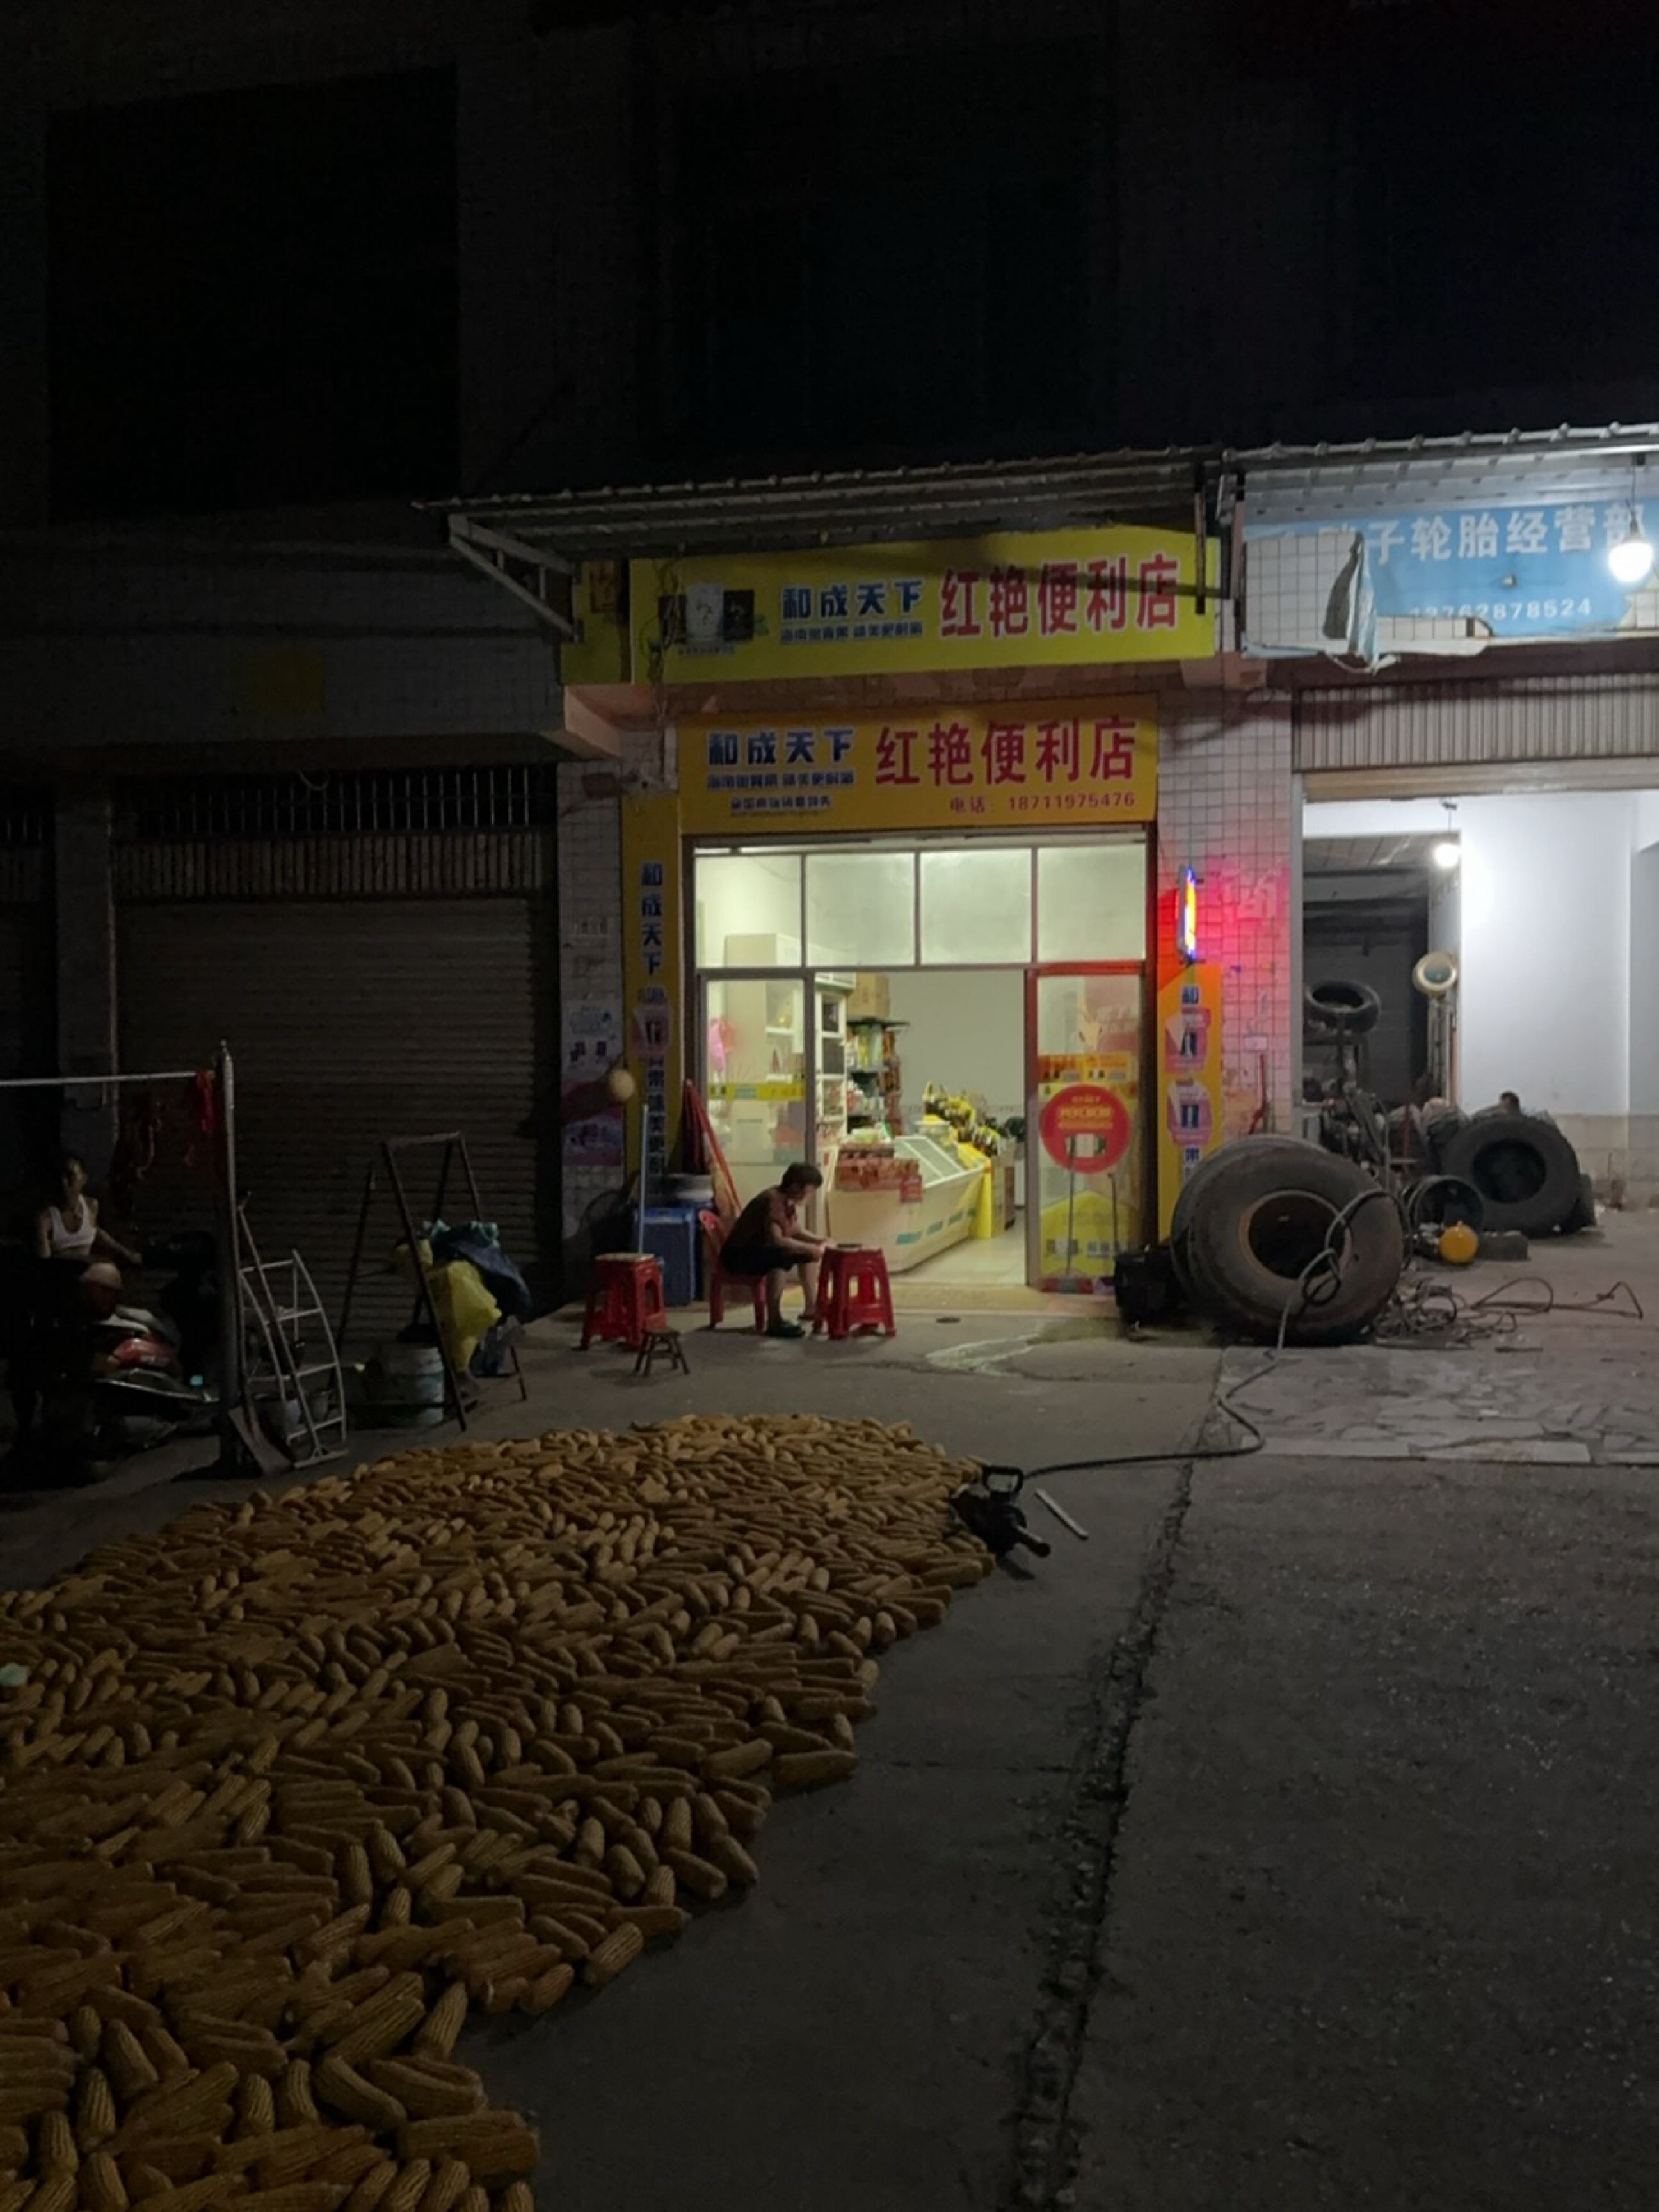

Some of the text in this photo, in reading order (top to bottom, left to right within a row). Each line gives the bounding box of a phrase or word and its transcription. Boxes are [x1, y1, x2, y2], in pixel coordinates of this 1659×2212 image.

[1320, 503, 1645, 565] 子轮胎经营部
[782, 581, 923, 620] 和成天下
[940, 554, 1179, 637] 红艳便利店
[708, 728, 853, 765] 和成天下
[875, 716, 1136, 786] 红艳便利店
[1009, 792, 1135, 811] 18711975476
[641, 862, 662, 976] 和成天下
